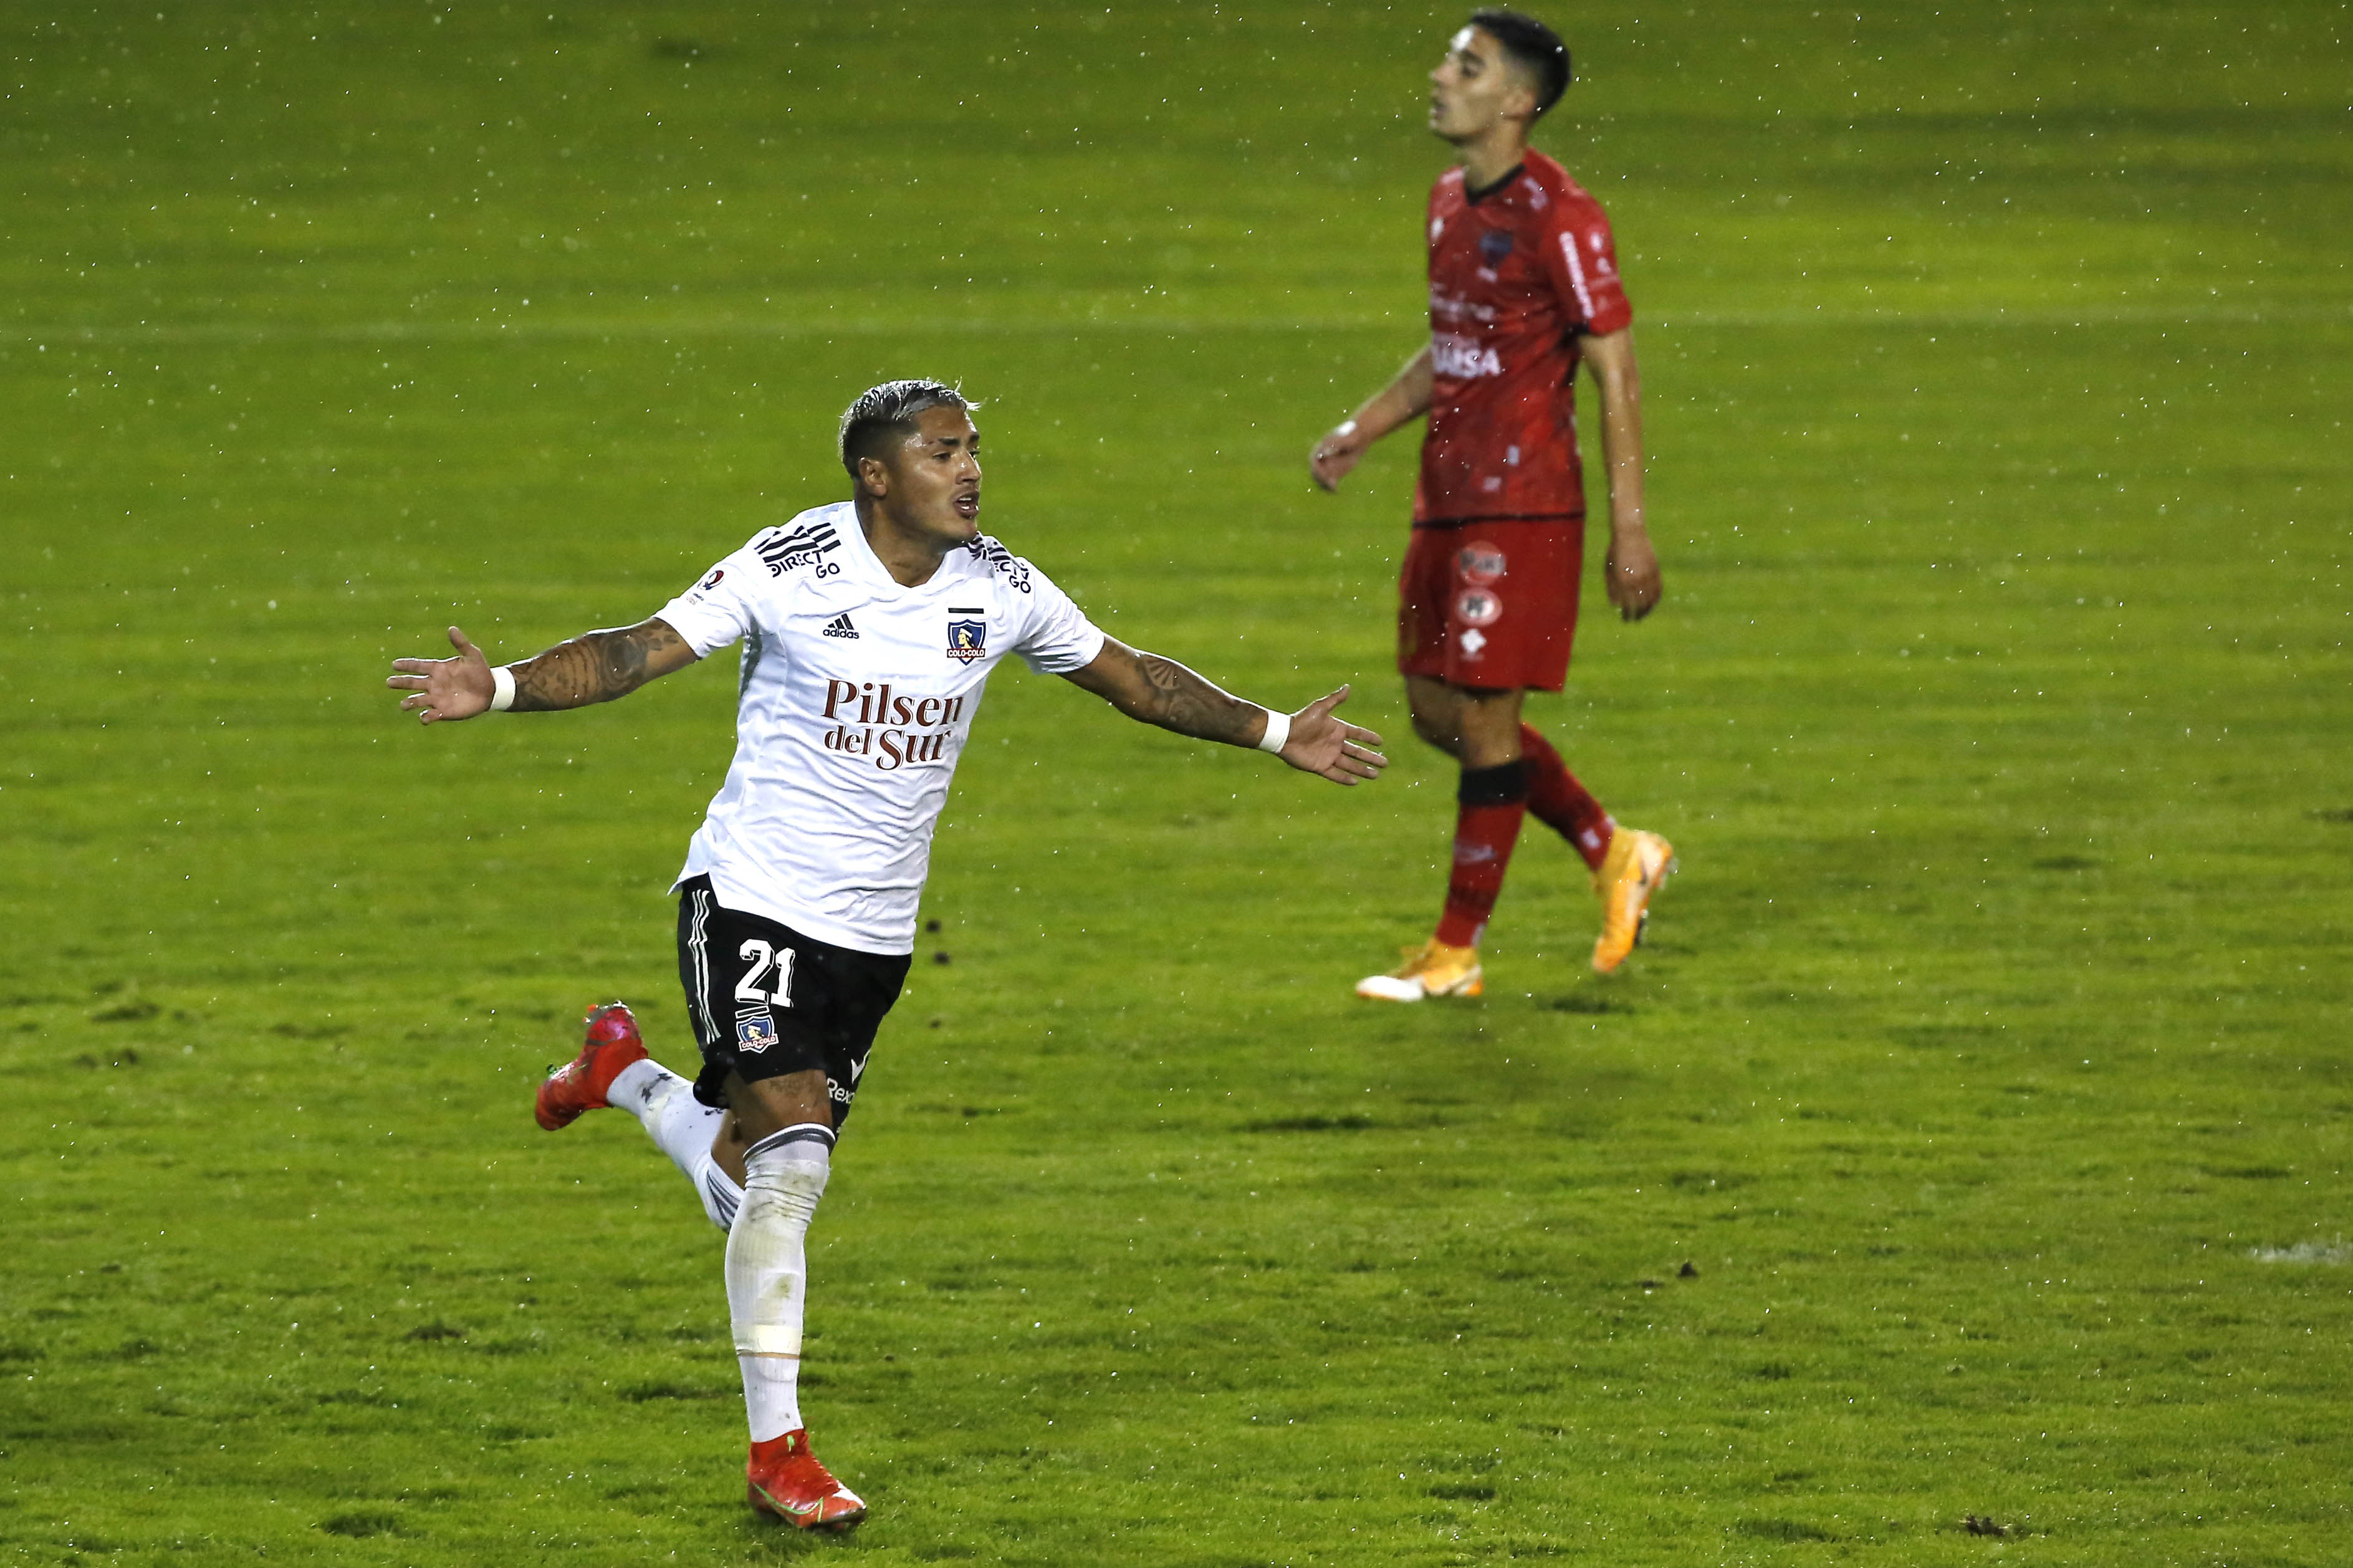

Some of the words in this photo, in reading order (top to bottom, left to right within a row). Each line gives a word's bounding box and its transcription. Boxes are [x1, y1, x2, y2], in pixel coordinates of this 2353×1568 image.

[815, 562, 841, 579] GO
[1009, 575, 1032, 594] GO
[823, 628, 860, 639] adidas
[947, 649, 985, 657] COLO-COLO
[820, 678, 964, 727] Pilsen
[824, 725, 873, 755] del
[876, 729, 952, 770] Sur
[734, 939, 796, 1008] 21
[741, 1036, 776, 1049] COLO-COLO
